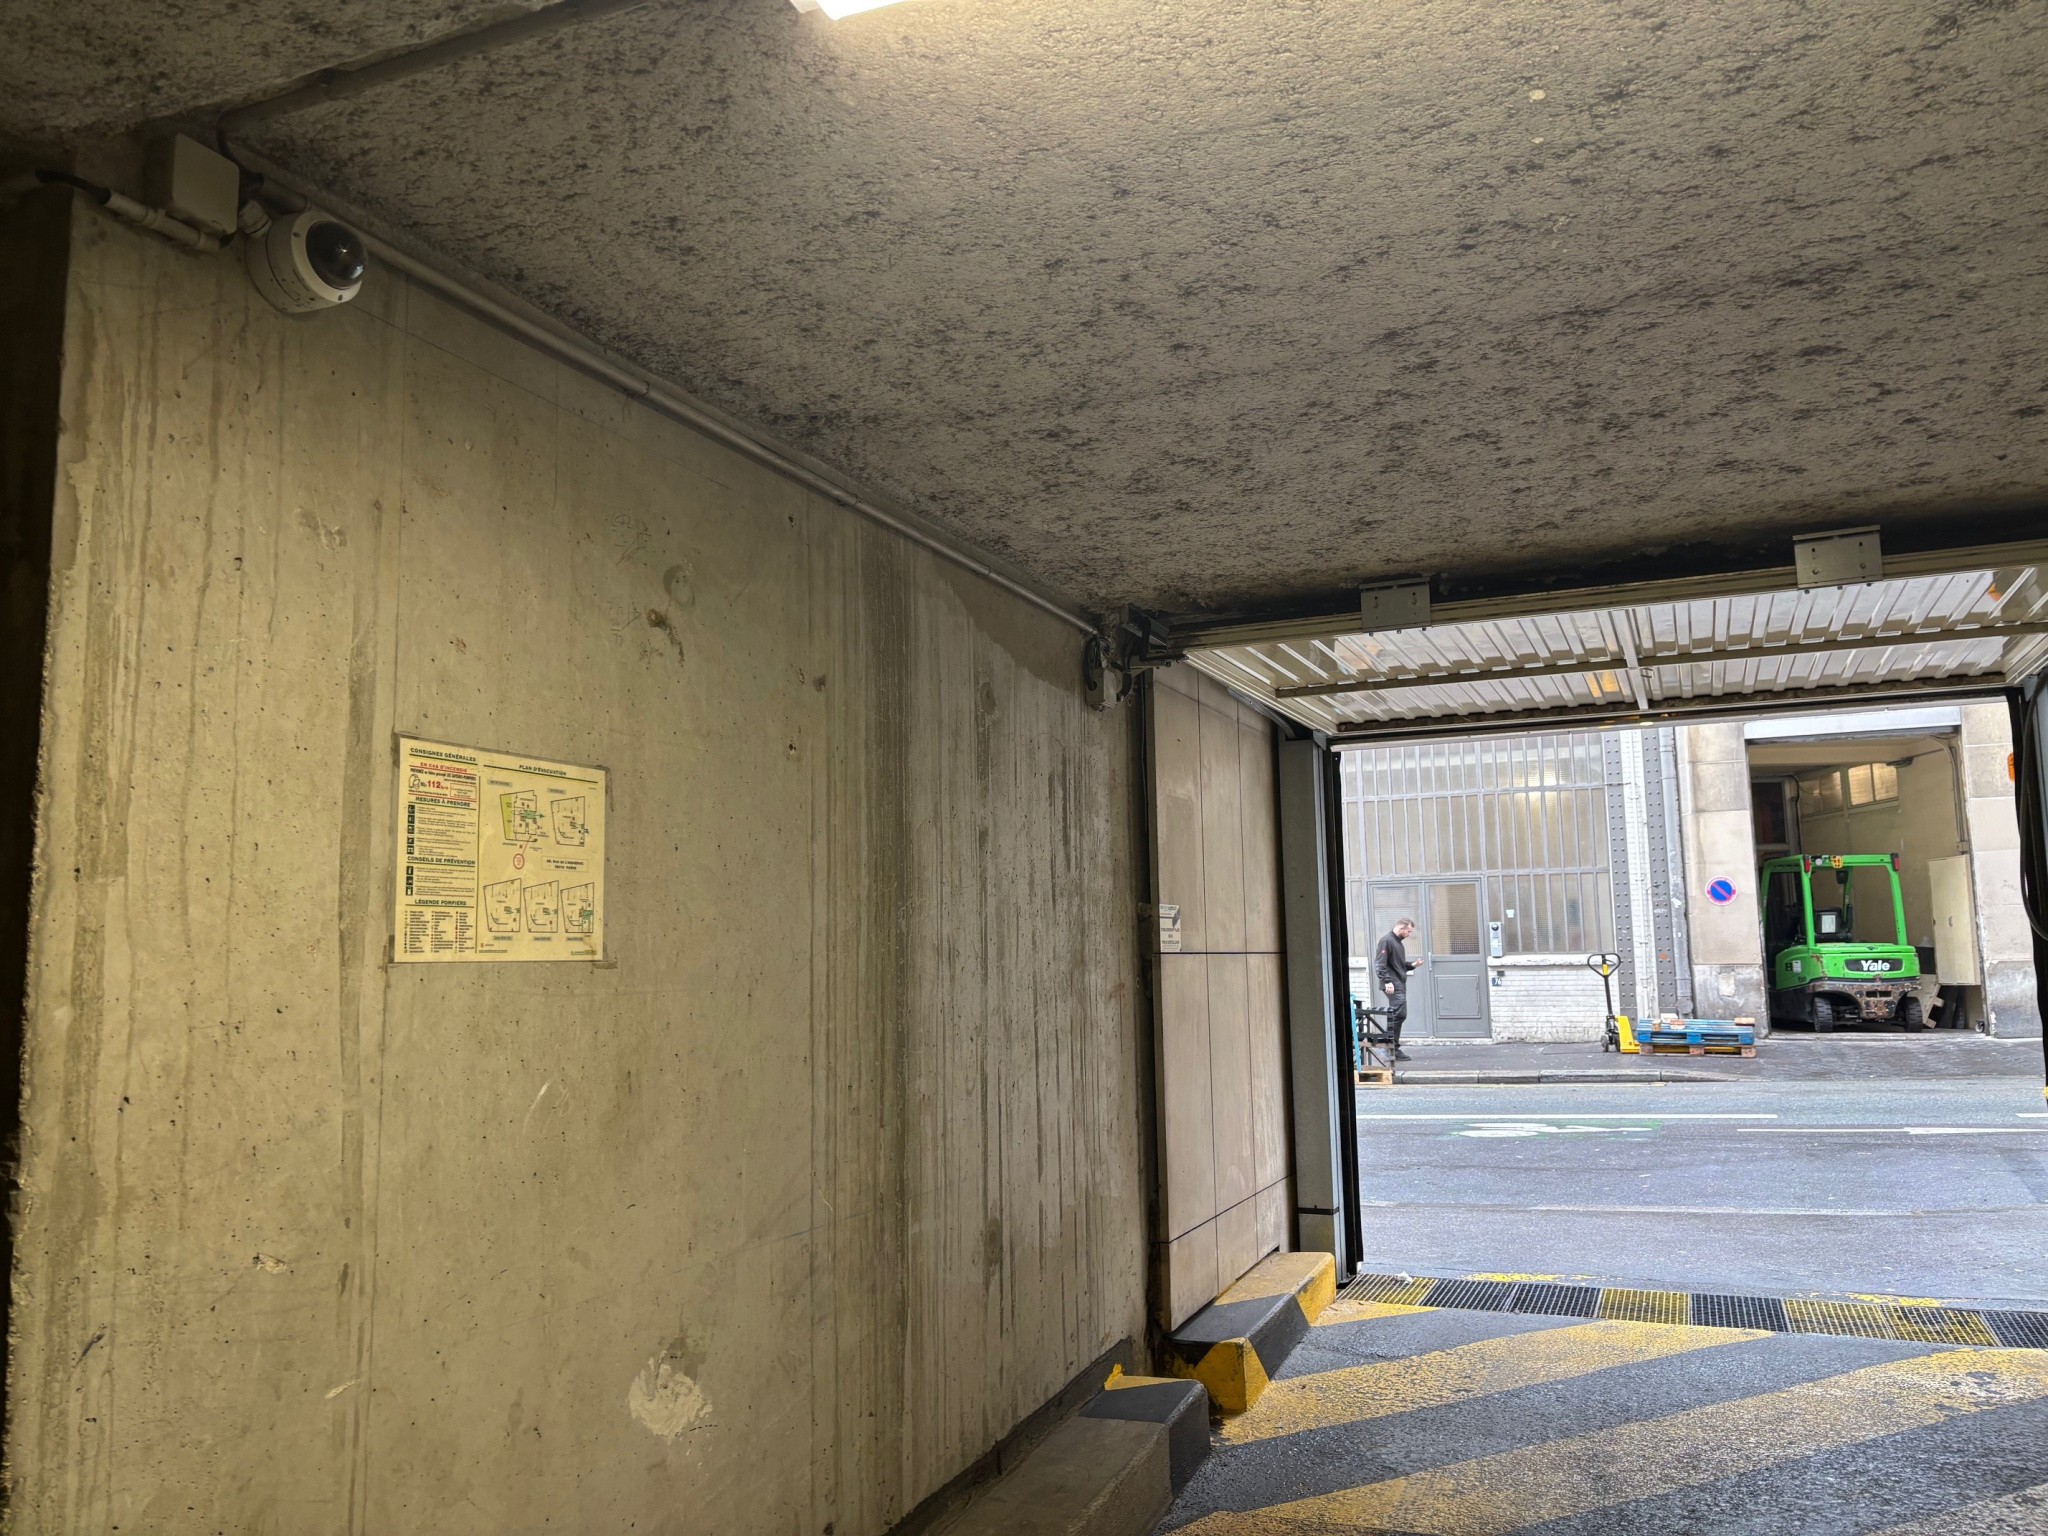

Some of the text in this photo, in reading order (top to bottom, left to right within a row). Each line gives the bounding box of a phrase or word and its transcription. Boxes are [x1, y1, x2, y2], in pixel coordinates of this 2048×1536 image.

[410, 747, 477, 762] CONSIGNES GÉNÉRALES
[427, 780, 441, 789] 112
[415, 796, 441, 804] MESURES
[444, 857, 476, 865] PRÉVENTION
[1860, 959, 1891, 971] Yale
